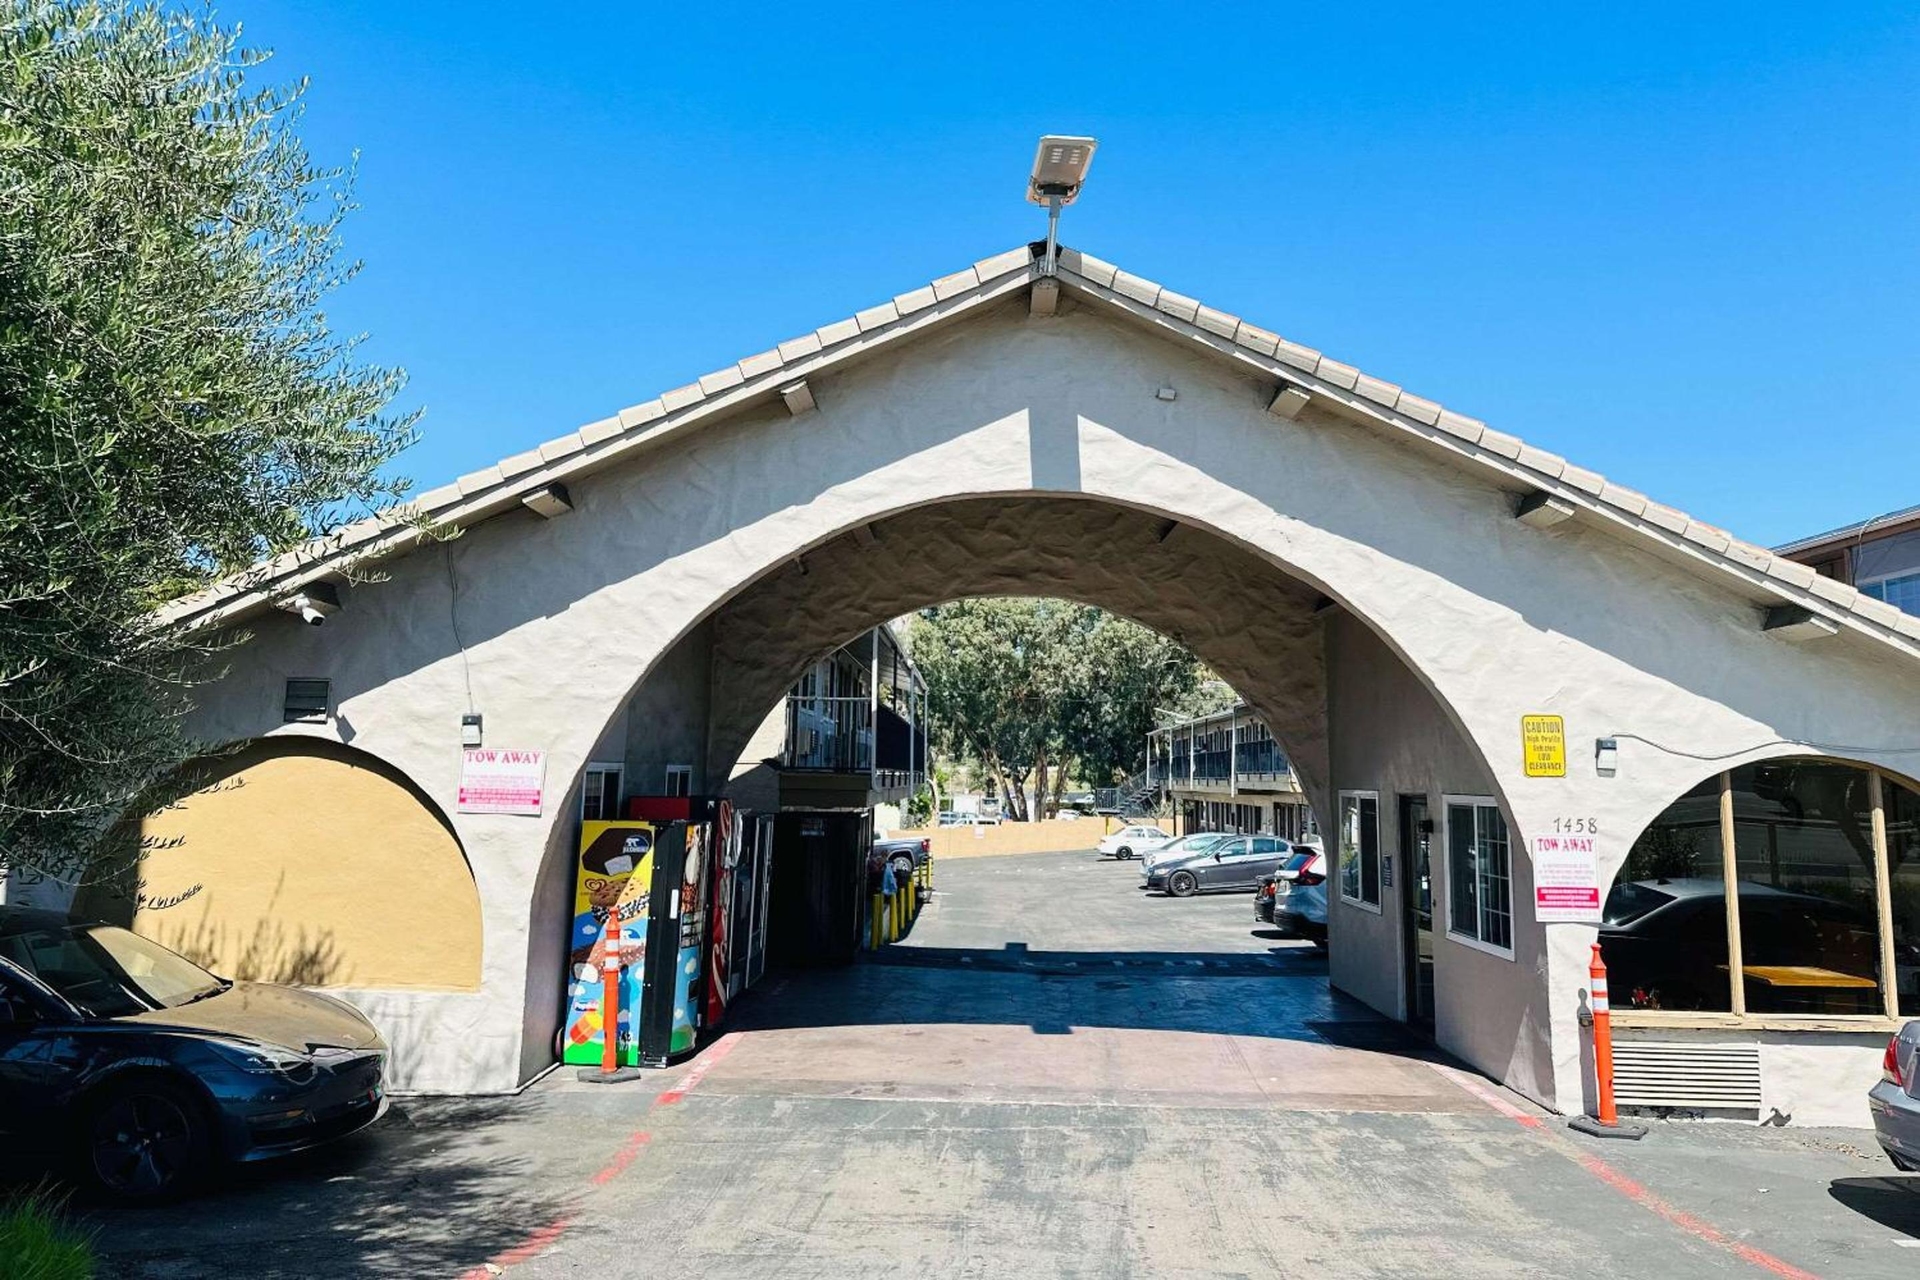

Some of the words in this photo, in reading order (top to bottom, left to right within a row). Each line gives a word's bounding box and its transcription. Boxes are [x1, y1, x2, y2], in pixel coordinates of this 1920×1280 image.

[1526, 721, 1560, 733] CAUTION
[466, 751, 497, 762] TOW
[501, 751, 541, 764] AWAY
[1554, 817, 1598, 834] 1458
[1537, 838, 1559, 852] TOW
[1562, 838, 1594, 852] AWAY
